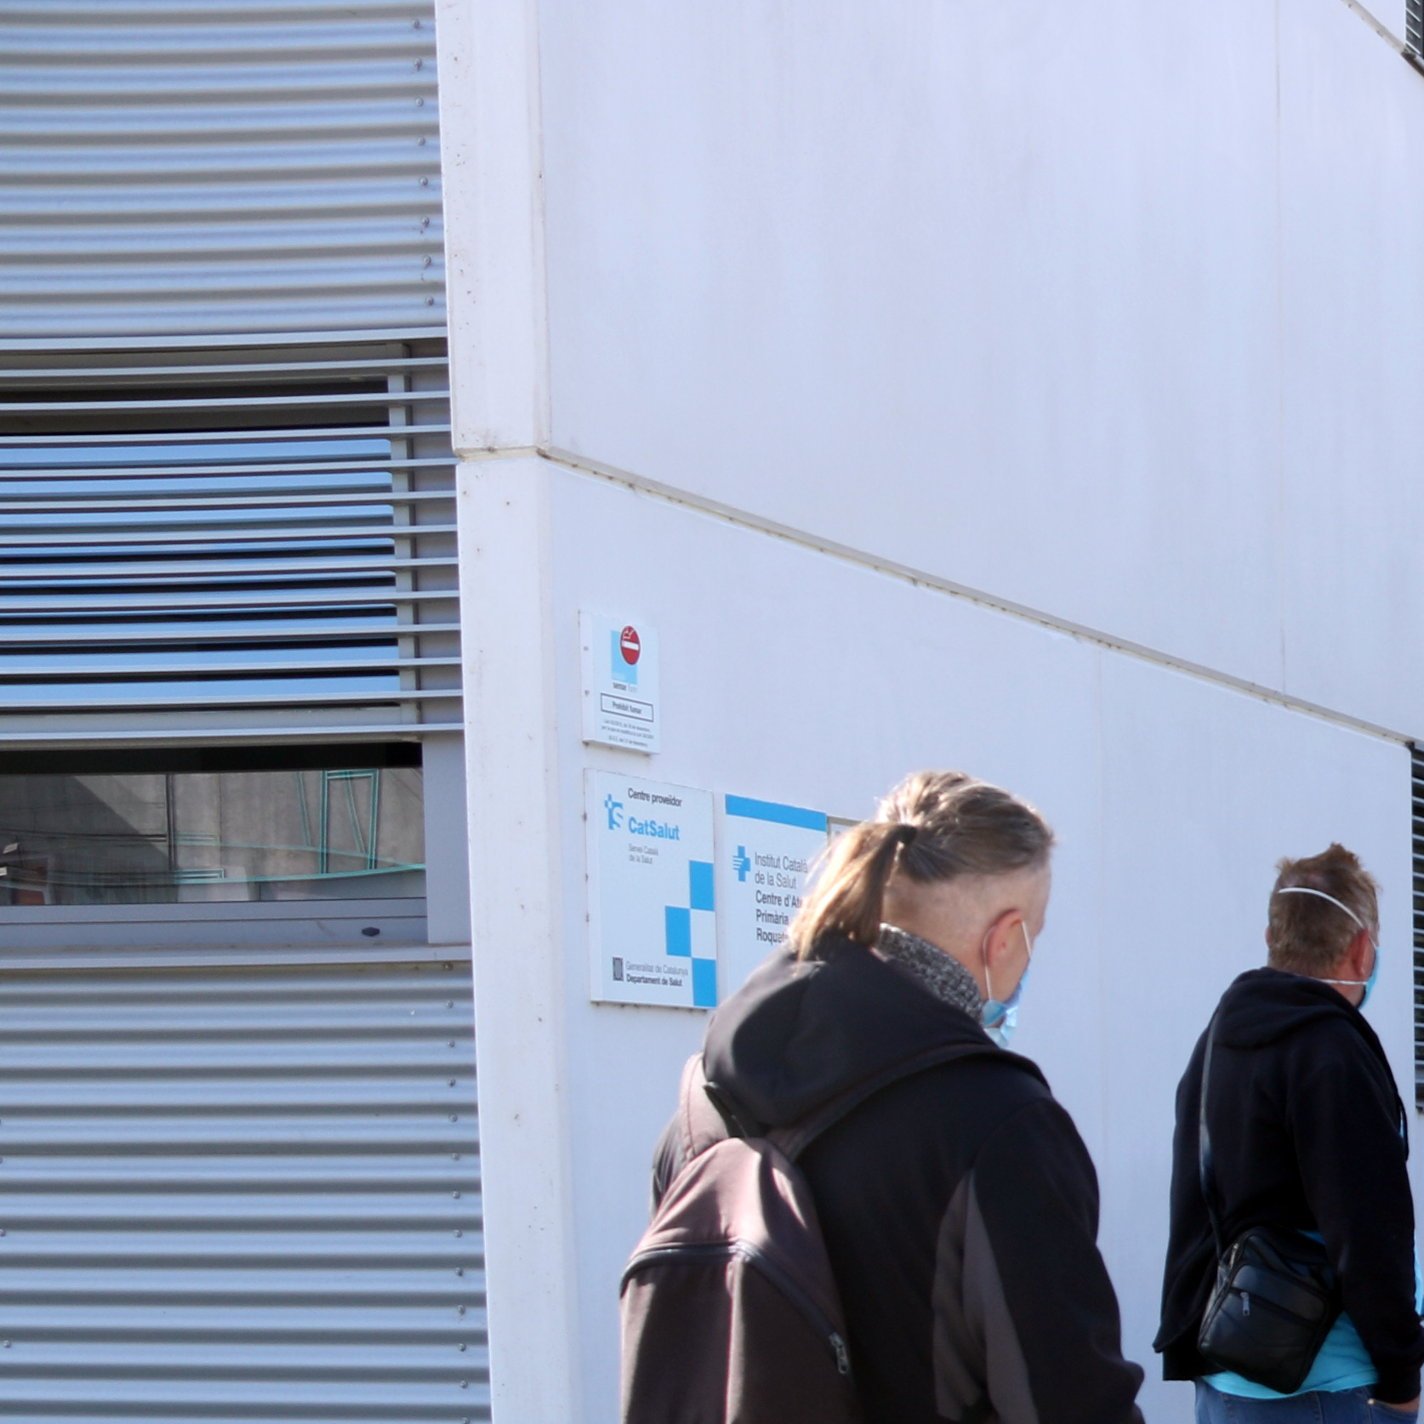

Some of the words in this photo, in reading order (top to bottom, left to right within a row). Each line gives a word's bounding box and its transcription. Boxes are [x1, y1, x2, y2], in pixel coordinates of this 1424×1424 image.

[628, 788, 650, 801] Centre
[628, 816, 680, 841] CatSalut
[755, 852, 780, 869] Institut
[782, 856, 809, 873] Català
[755, 871, 765, 885] de
[767, 872, 775, 886] la
[776, 873, 797, 889] Salut
[755, 890, 782, 906] Centre
[755, 909, 789, 925] Primària
[661, 977, 668, 986] de
[669, 977, 683, 987] Salut
